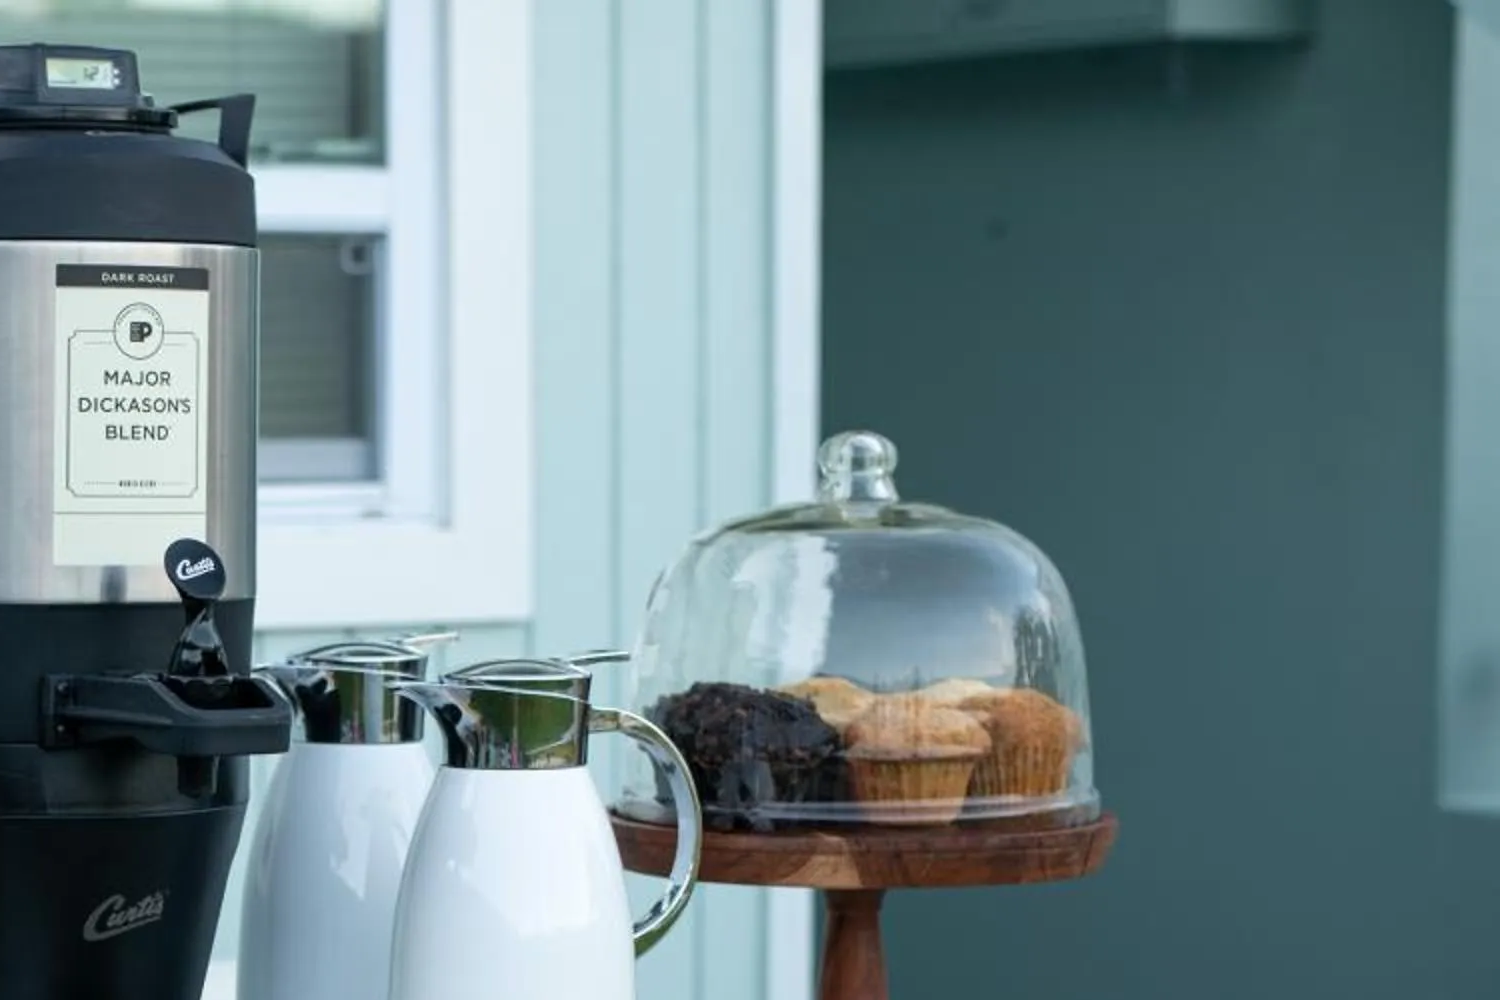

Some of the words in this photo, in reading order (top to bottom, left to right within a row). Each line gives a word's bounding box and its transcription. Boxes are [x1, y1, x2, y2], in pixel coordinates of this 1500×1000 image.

[101, 271, 135, 283] DARK
[138, 273, 175, 285] ROAST
[103, 371, 171, 387] MAJOR
[78, 397, 191, 414] DICKASON'S
[105, 425, 170, 440] BLEND
[175, 557, 216, 581] Curtis
